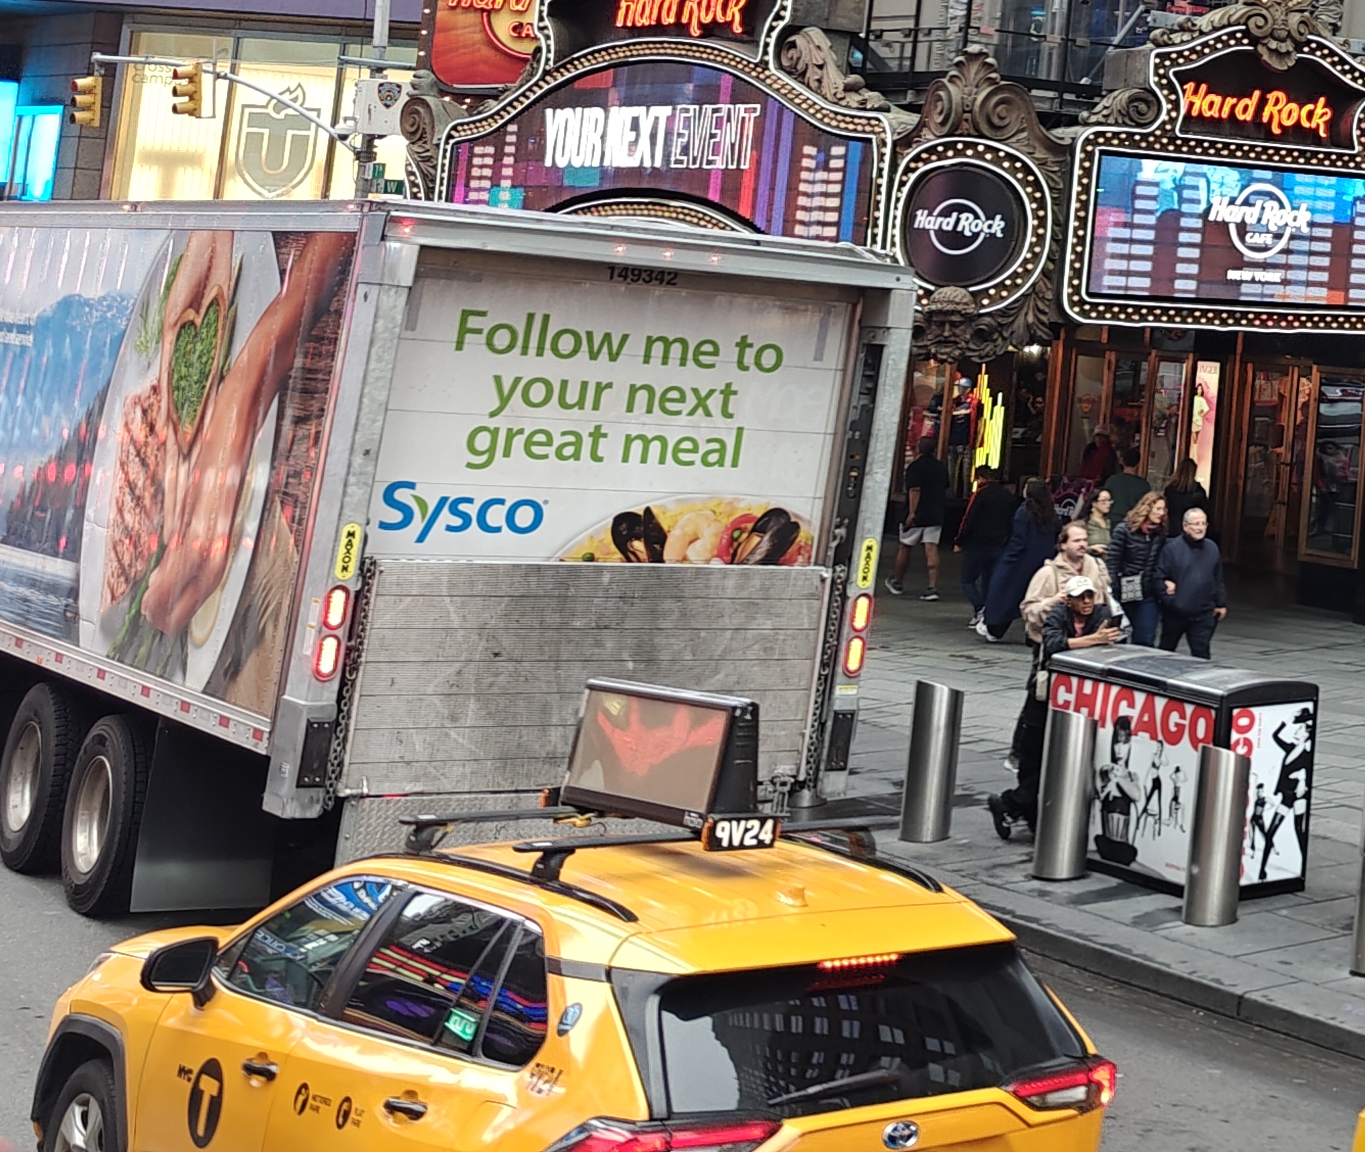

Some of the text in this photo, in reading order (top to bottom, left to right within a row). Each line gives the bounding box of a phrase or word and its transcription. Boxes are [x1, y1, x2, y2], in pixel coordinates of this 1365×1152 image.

[1182, 82, 1335, 138] Hard Rock
[544, 104, 761, 169] YOUR NEXT EVENT
[914, 211, 1005, 239] Hard Rock
[1209, 196, 1311, 235] Hard Rock
[1245, 232, 1274, 246] CAFE
[607, 265, 678, 286] 149342
[454, 308, 784, 373] Follow me to
[488, 374, 738, 419] your next
[465, 424, 745, 470] great meal
[378, 480, 545, 544] Sysco
[341, 530, 356, 573] MAXON
[1051, 673, 1215, 752] CHICAGO
[715, 818, 775, 847] 9V24
